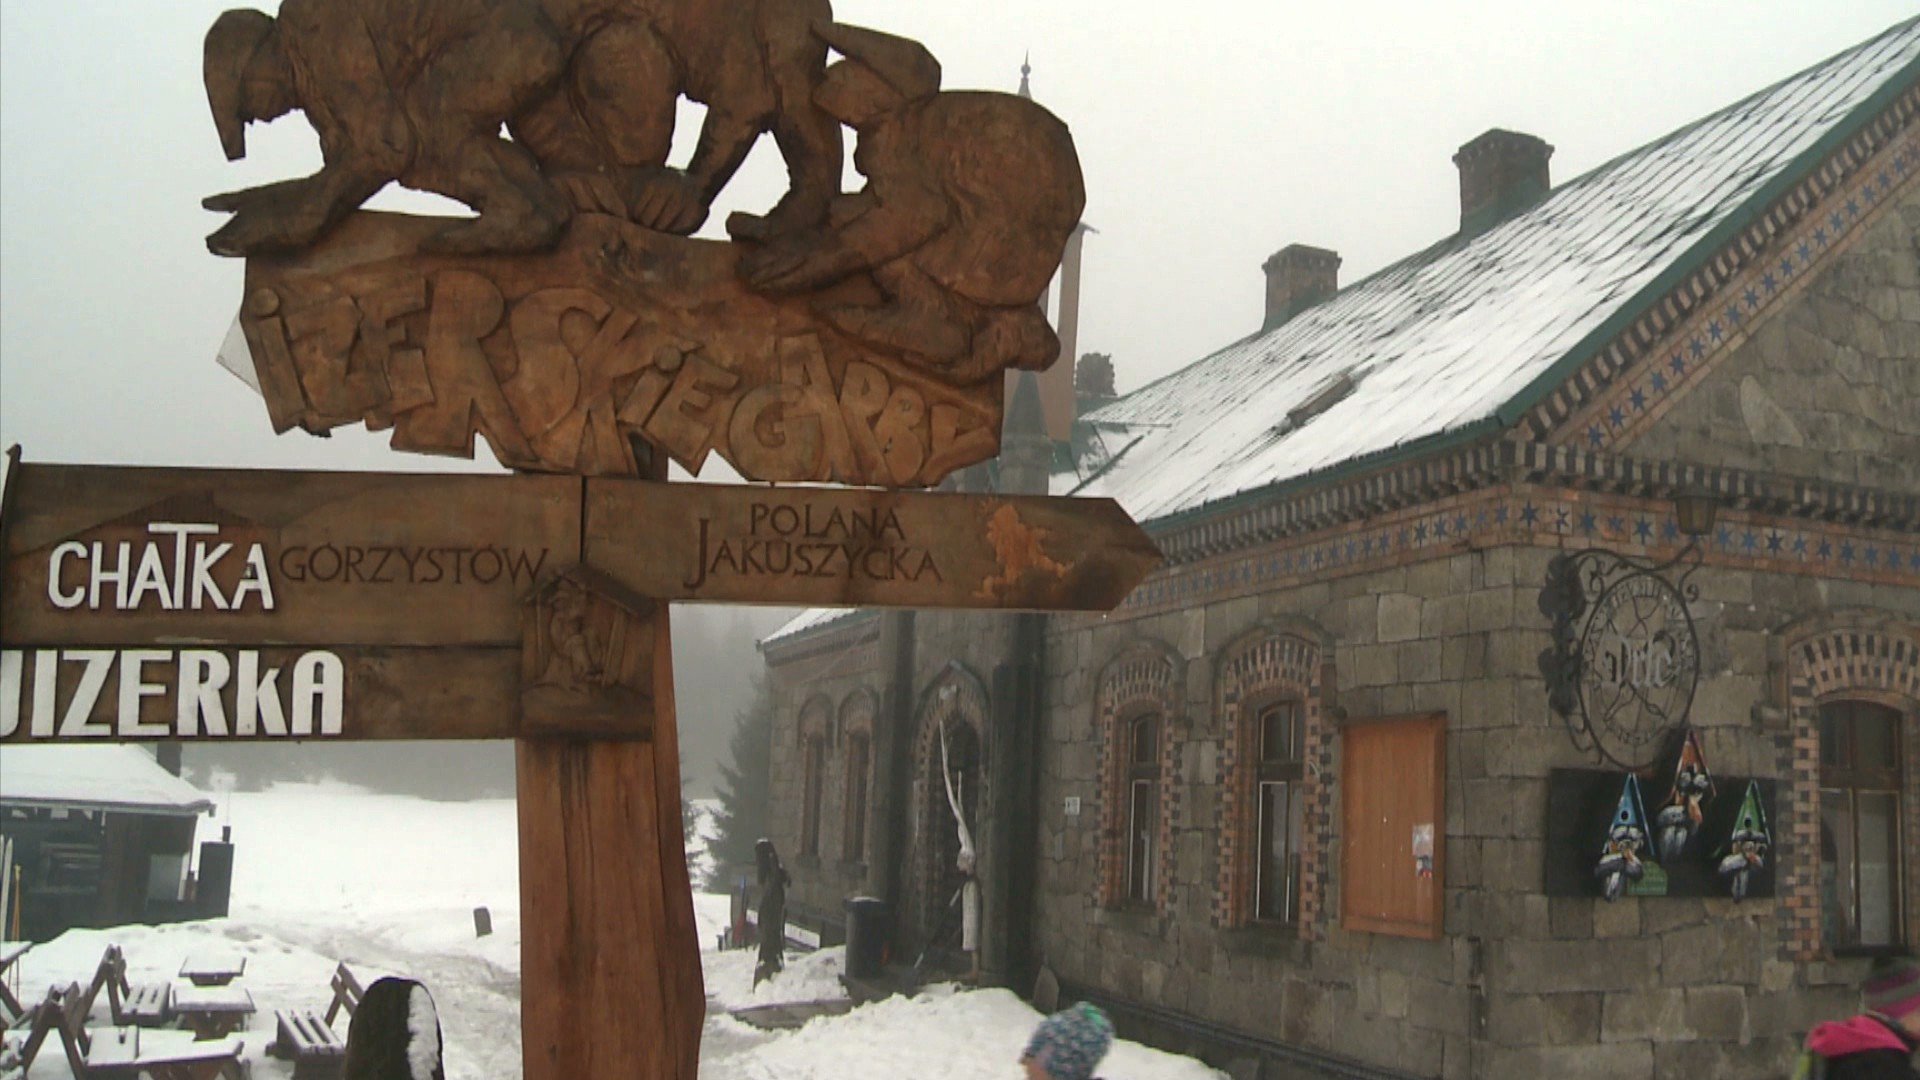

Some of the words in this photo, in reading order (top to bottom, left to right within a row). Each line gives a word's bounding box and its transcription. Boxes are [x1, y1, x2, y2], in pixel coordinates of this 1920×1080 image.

[684, 518, 943, 589] JAKUSZYCKA
[751, 503, 906, 540] POLANA
[47, 522, 274, 610] CHATKA
